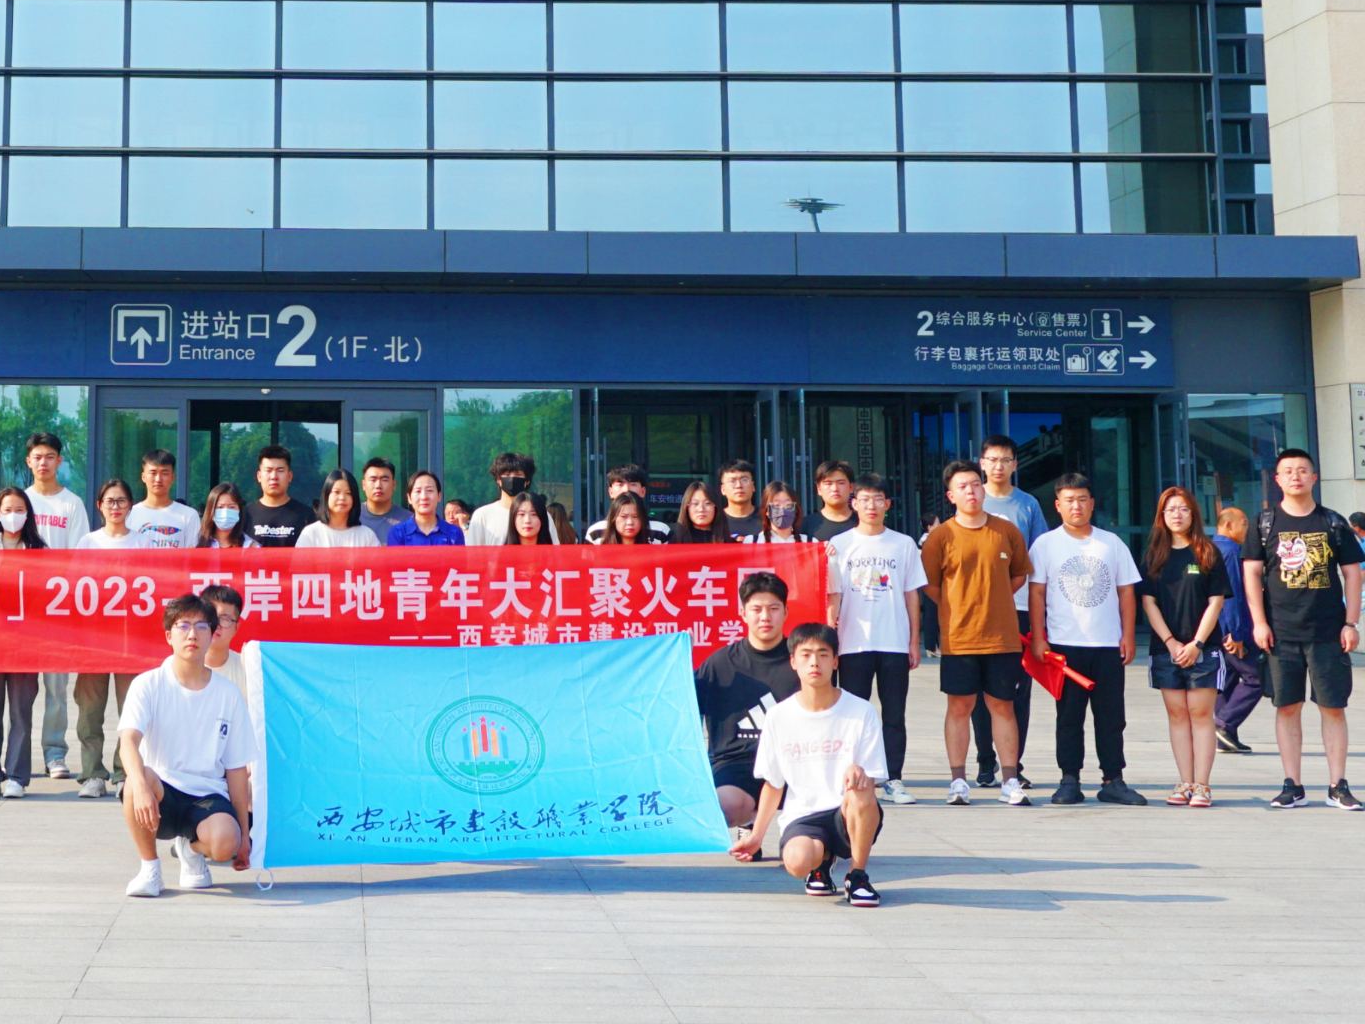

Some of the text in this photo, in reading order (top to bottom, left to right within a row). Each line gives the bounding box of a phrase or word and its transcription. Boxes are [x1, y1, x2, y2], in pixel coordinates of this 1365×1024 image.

[916, 311, 935, 336] 2
[180, 311, 270, 339] 进站口
[274, 305, 317, 367] 2
[1017, 328, 1087, 337] Service Center
[179, 344, 255, 361] Entrance
[914, 346, 1061, 362] 行李包裹托运领取处
[951, 363, 986, 371] Baggage
[449, 829, 589, 843] ARCHITECTURAL
[599, 817, 674, 834] COLLEGE
